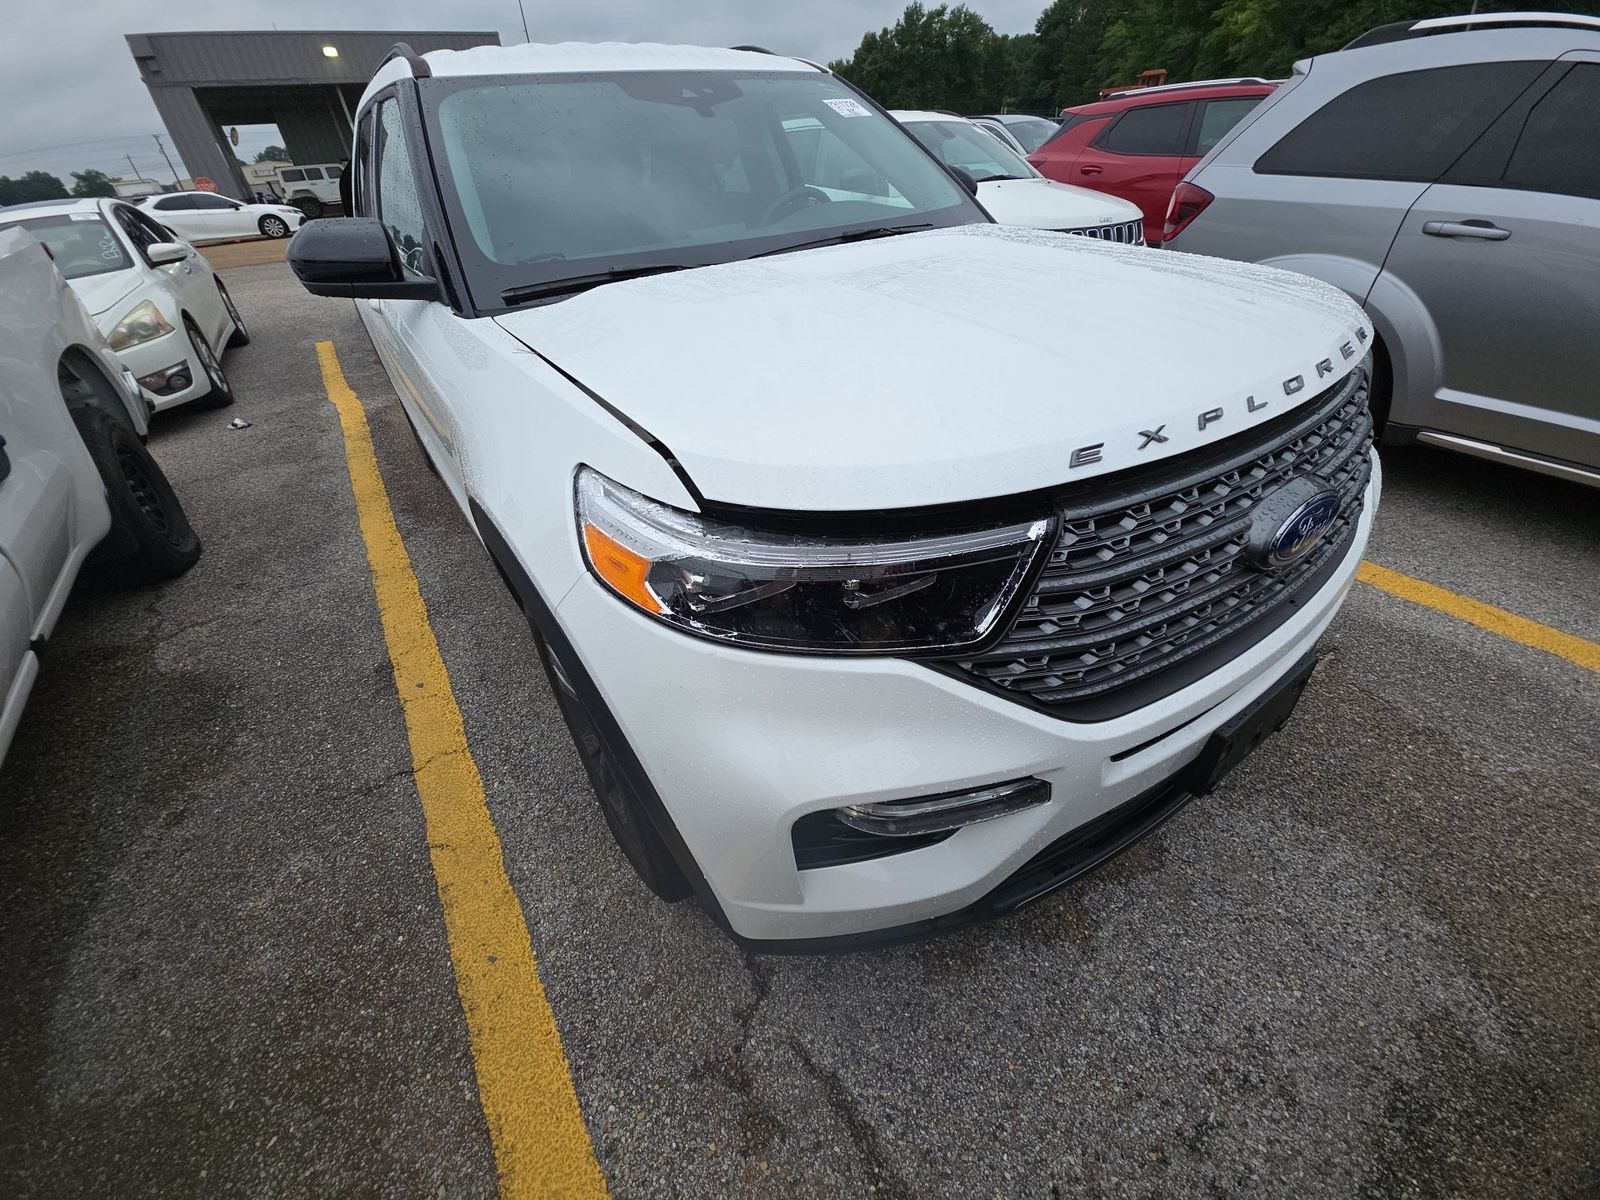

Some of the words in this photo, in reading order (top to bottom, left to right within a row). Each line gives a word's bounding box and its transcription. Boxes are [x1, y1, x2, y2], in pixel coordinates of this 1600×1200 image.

[197, 183, 216, 192] STOP
[1068, 326, 1368, 469] EXPLORER
[1291, 507, 1332, 553] Ford
